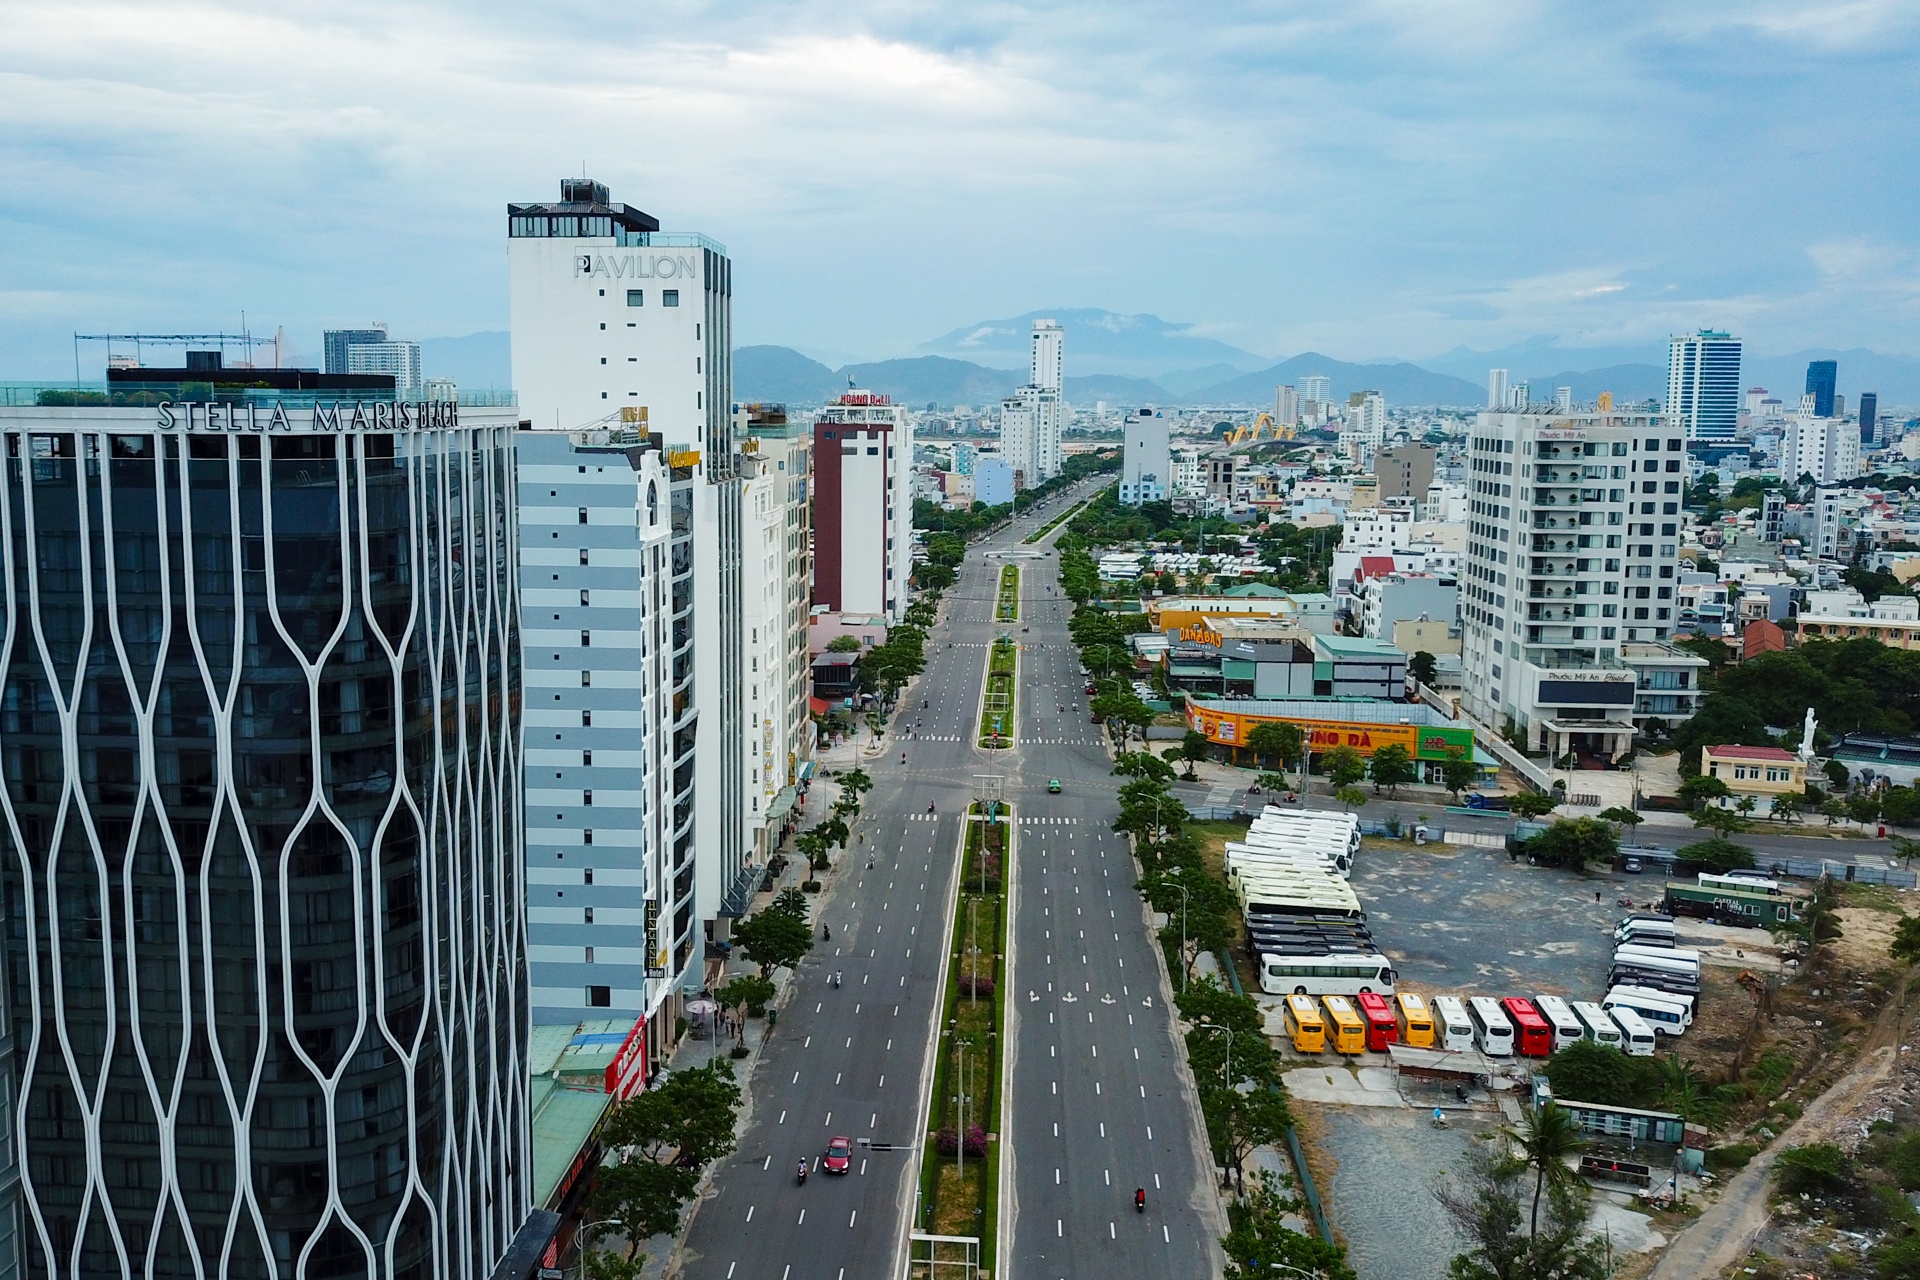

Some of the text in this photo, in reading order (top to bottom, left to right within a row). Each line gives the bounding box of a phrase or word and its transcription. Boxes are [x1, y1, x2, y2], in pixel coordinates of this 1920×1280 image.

[574, 255, 696, 279] PAVILION
[157, 400, 459, 431] STELLA MARIS BEACH
[1576, 431, 1586, 439] An
[1589, 673, 1600, 681] An
